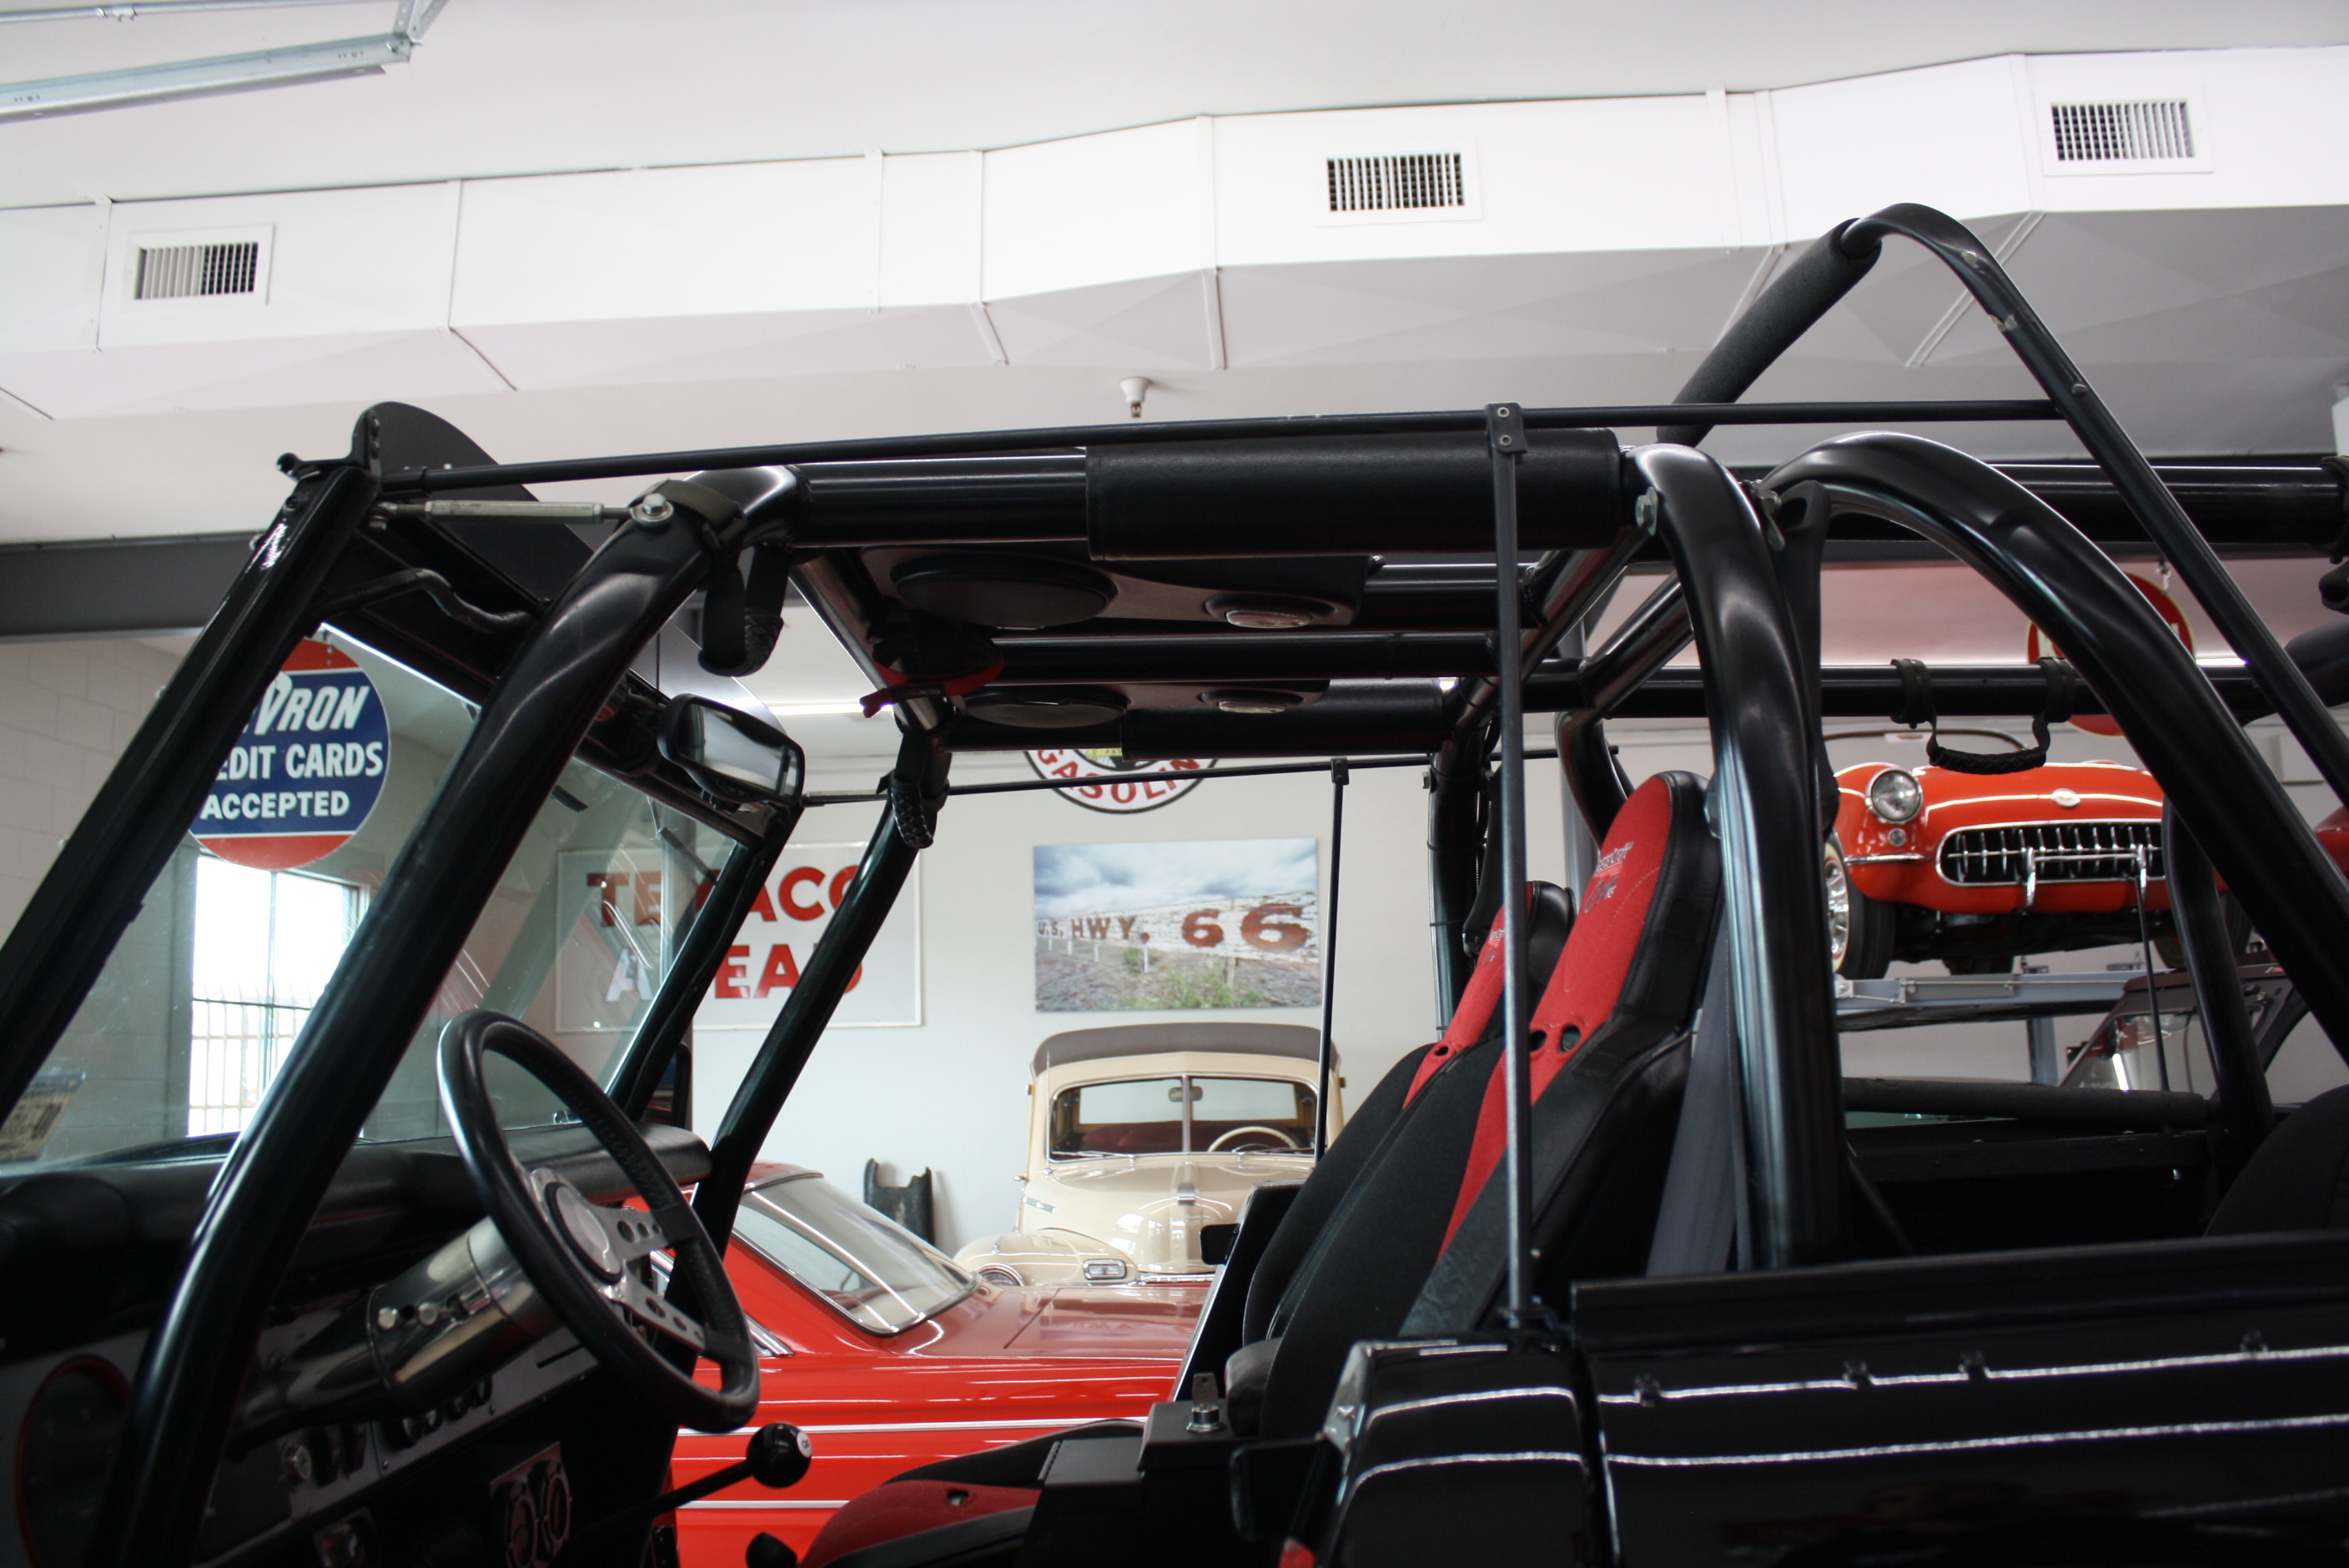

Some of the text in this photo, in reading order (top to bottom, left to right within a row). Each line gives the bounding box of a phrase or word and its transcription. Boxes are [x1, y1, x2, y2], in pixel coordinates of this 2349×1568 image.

[242, 671, 370, 735] VRON
[285, 741, 383, 778] CARDS
[199, 791, 350, 820] ACCEPTED
